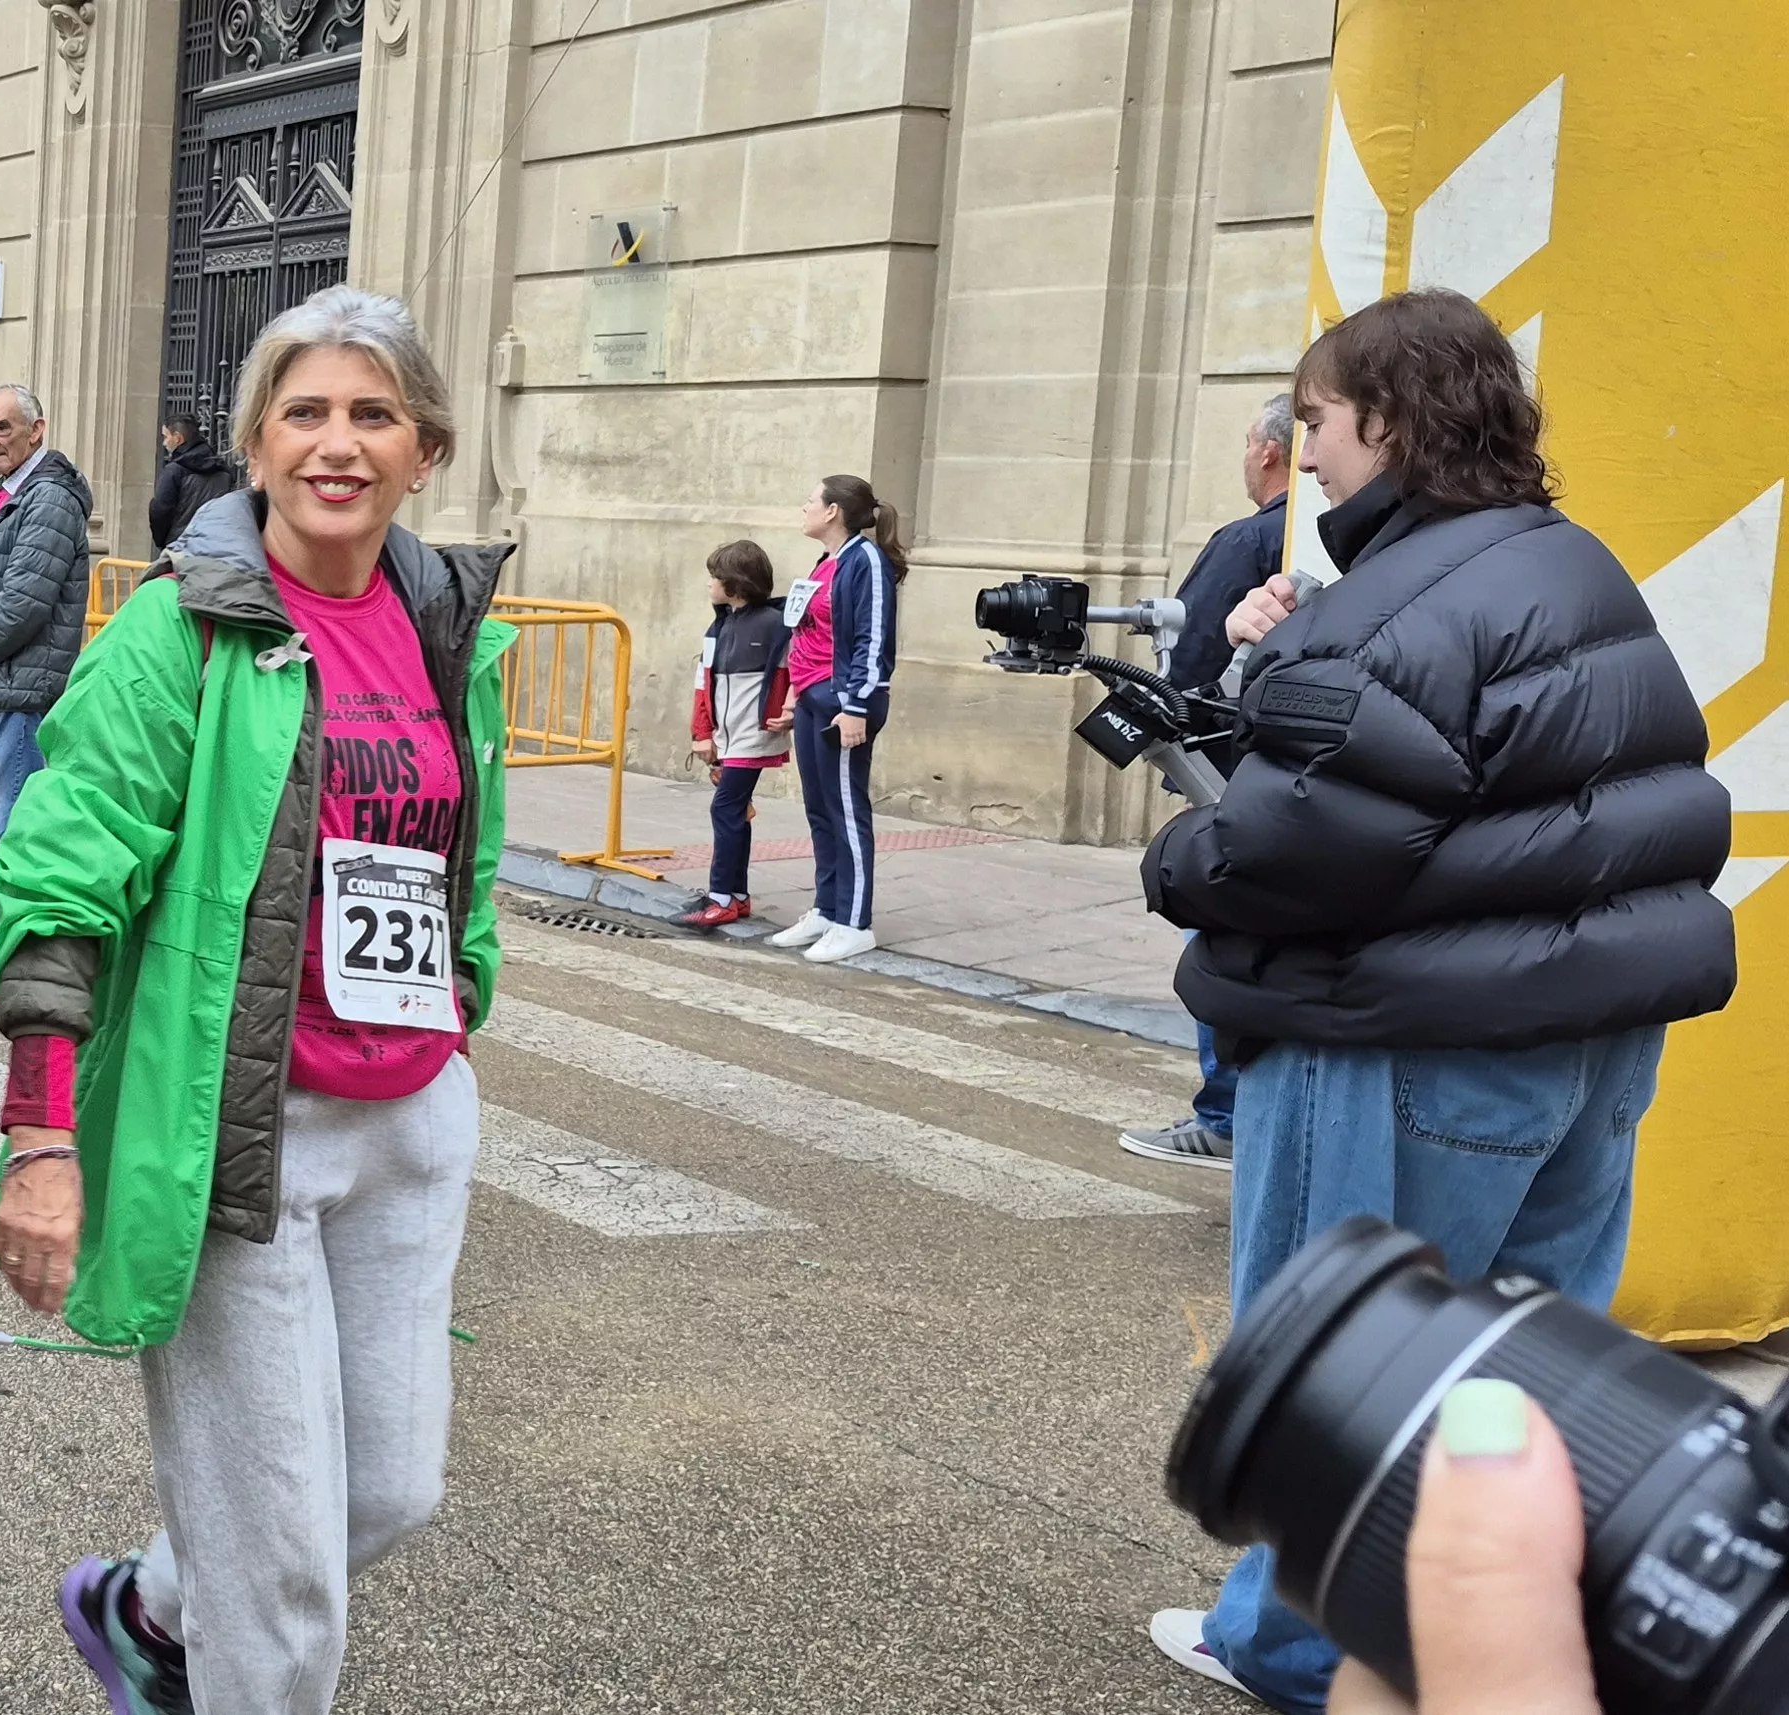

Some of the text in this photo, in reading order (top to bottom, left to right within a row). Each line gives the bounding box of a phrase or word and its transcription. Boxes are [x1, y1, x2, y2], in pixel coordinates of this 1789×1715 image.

[790, 594, 804, 613] 12
[1271, 686, 1323, 704] adidas
[344, 709, 396, 723] CONTRA
[353, 798, 393, 845] EN
[346, 877, 409, 899] CONTRA
[410, 884, 423, 901] EL
